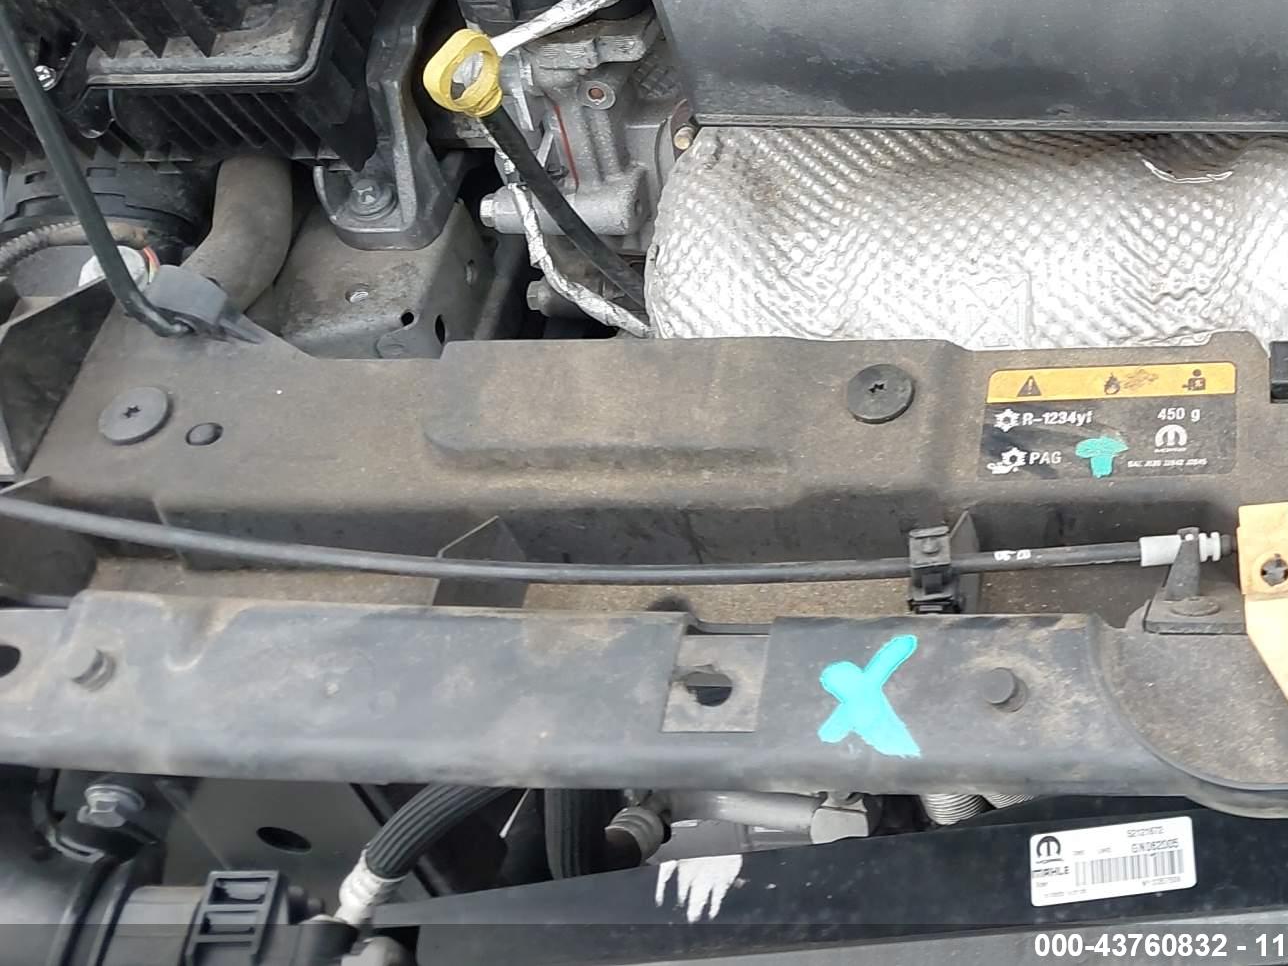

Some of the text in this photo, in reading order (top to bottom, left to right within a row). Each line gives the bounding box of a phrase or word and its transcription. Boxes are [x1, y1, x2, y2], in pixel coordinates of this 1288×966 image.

[1158, 407, 1186, 420] 450
[1191, 409, 1201, 422] g
[1029, 451, 1062, 465] PAG
